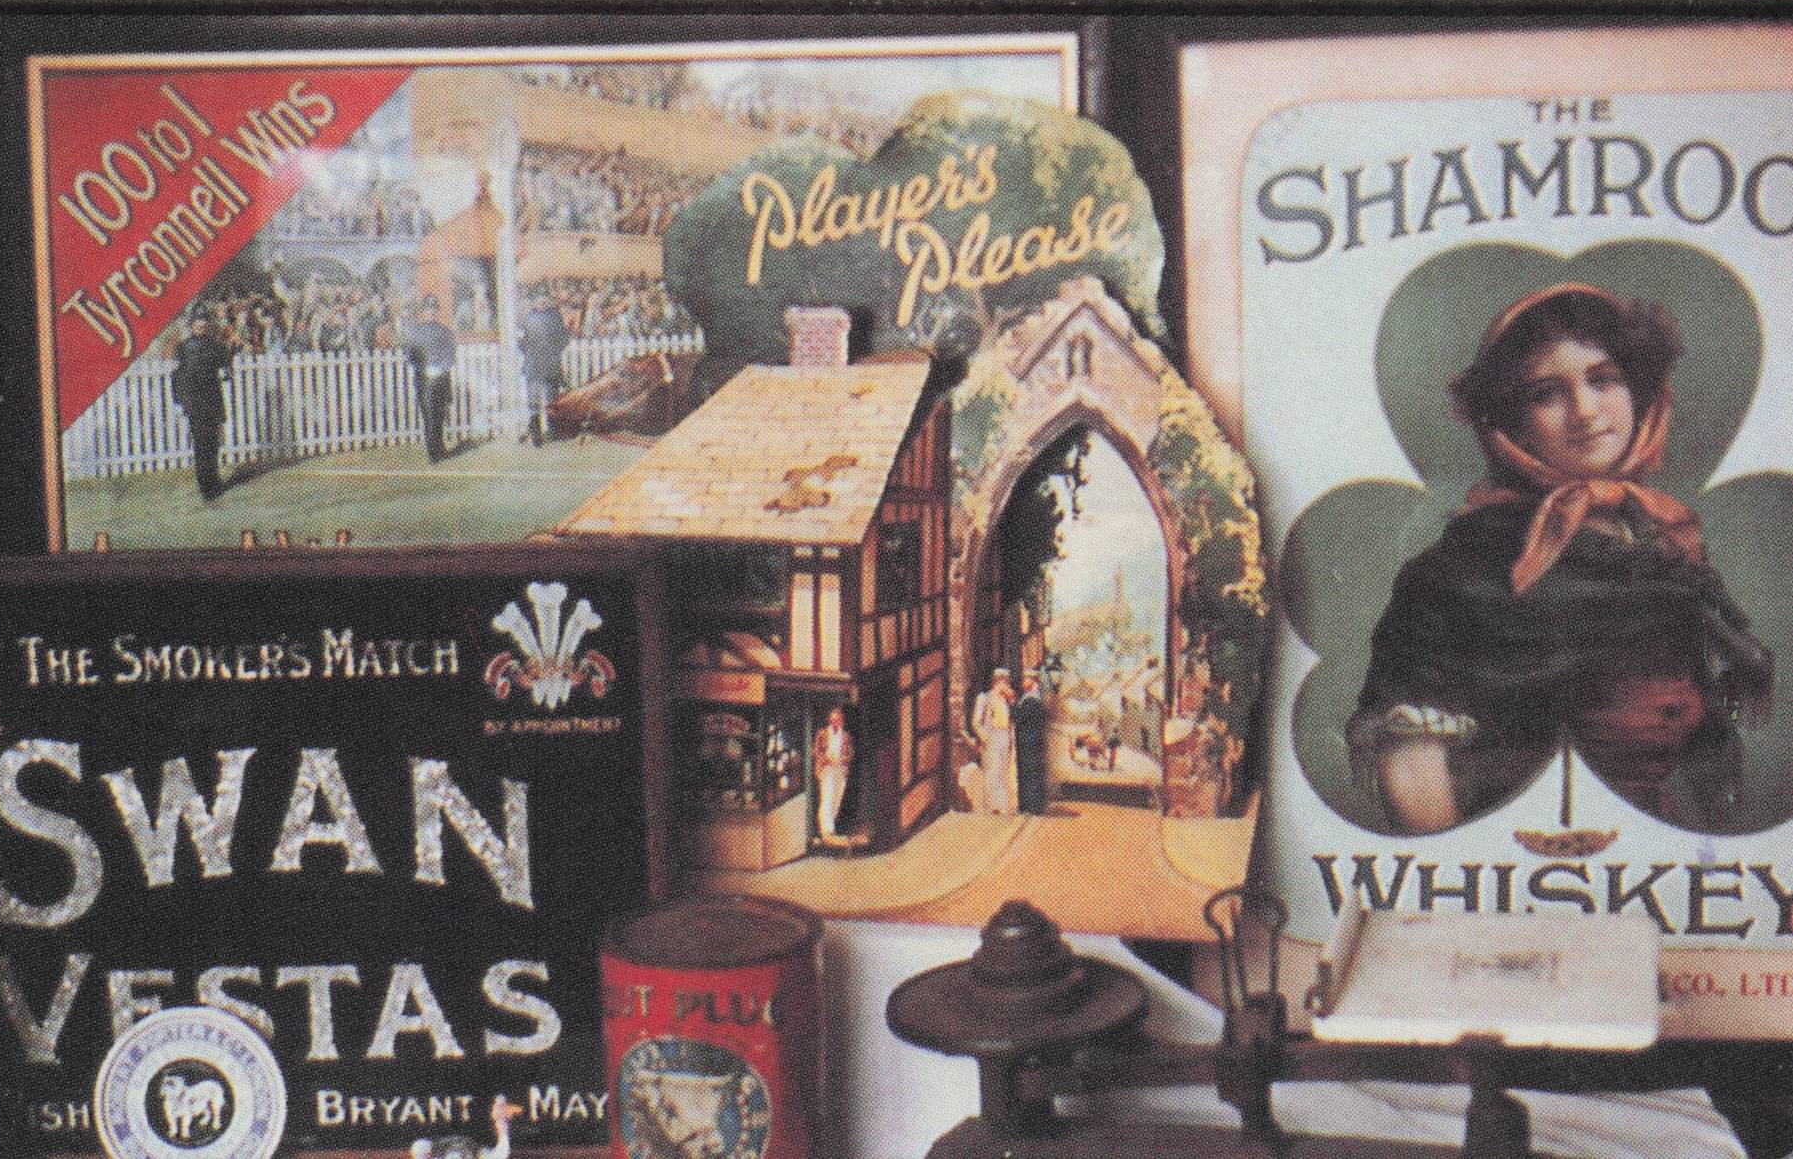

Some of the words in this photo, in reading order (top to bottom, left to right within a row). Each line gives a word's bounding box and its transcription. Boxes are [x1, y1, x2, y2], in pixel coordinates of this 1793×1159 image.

[160, 83, 213, 137] 1
[1526, 98, 1617, 124] THE
[136, 119, 194, 173] to
[58, 141, 158, 246] 100
[742, 142, 998, 284] Player's
[60, 156, 251, 358] Tyrconnell
[899, 193, 1132, 327] Please
[19, 634, 98, 685] THE
[322, 626, 460, 679] MATCH
[317, 1088, 477, 1127] BRYANT
[527, 1086, 610, 1125] MAY
